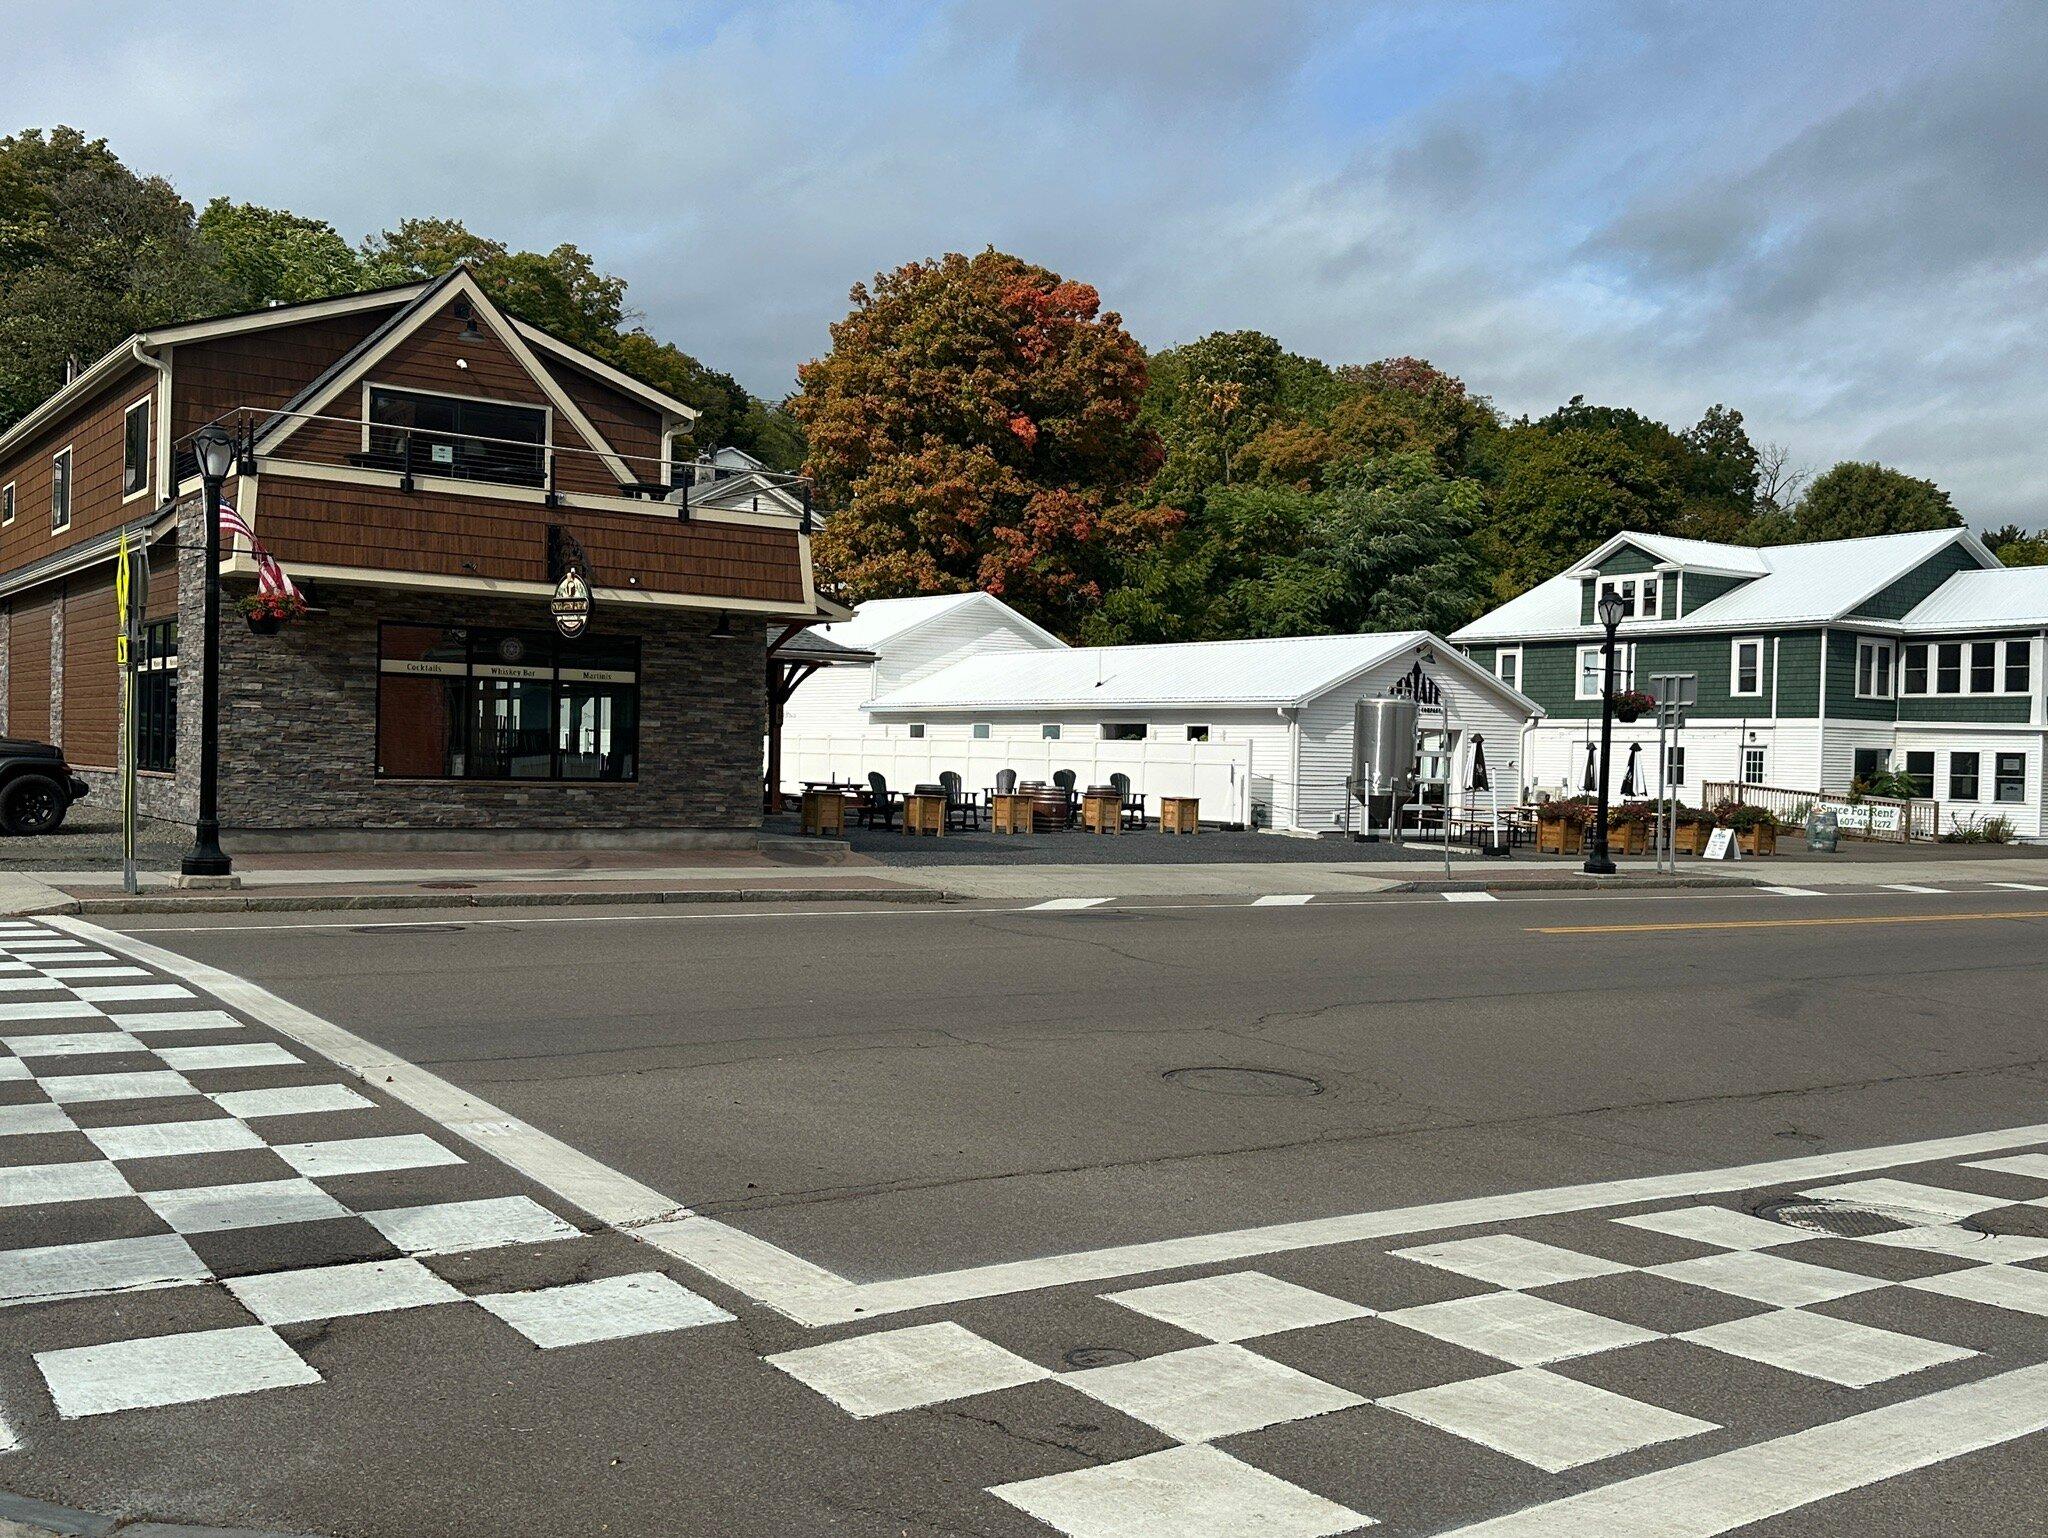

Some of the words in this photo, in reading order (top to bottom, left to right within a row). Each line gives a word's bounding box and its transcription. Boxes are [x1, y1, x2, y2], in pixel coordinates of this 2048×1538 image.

[406, 663, 442, 672] Cocktails
[490, 667, 521, 677] Whiskey
[523, 669, 535, 677] Bar
[582, 672, 612, 680] Martinis
[1851, 805, 1869, 816] For
[1871, 807, 1894, 818] Rent
[1839, 818, 1892, 828] 607-481272
